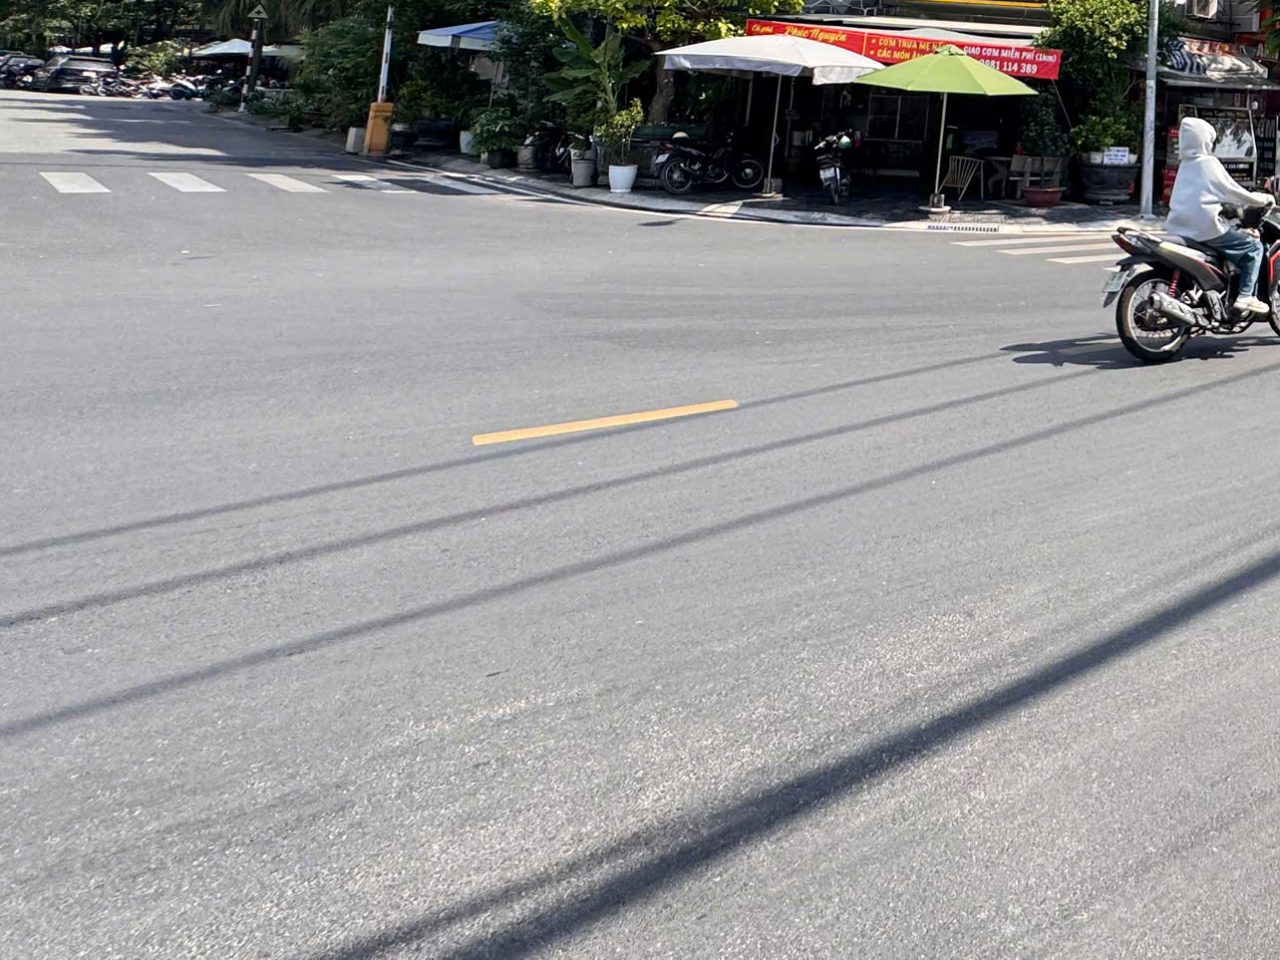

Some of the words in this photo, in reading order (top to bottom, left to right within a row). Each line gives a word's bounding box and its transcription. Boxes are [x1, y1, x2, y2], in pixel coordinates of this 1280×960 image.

[877, 47, 892, 58] CÁC
[893, 48, 911, 59] MÓN
[963, 45, 981, 54] GIAO
[1002, 61, 1018, 72] 114
